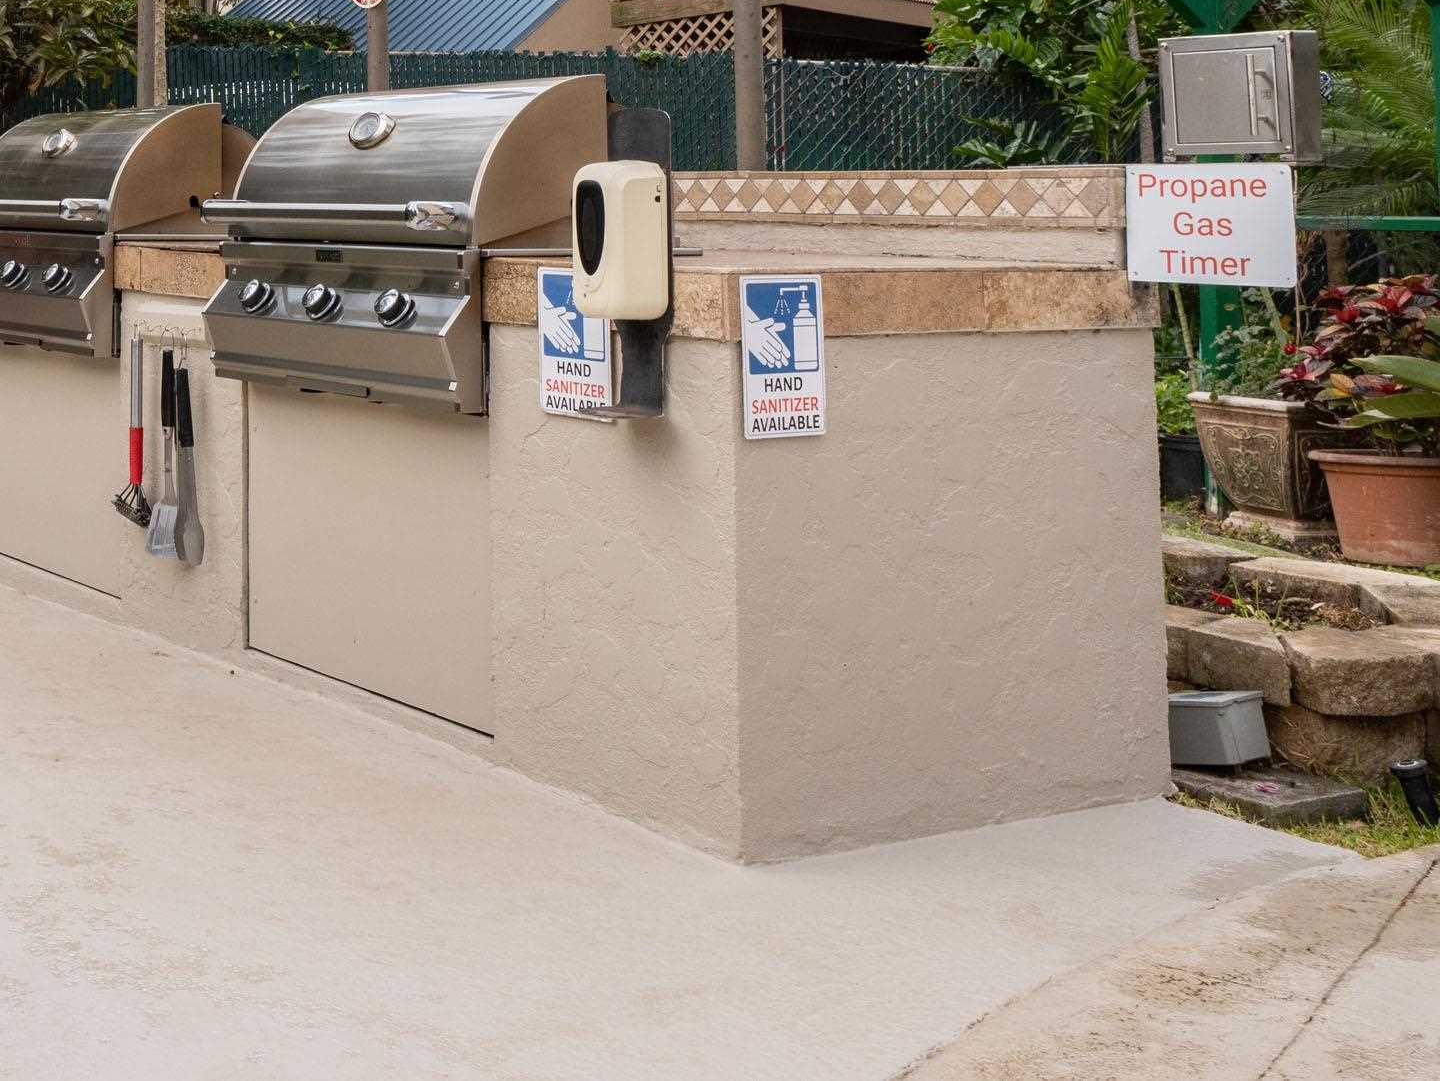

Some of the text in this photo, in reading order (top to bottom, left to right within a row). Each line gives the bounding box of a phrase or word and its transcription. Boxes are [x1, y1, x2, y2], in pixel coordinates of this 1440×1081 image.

[1138, 174, 1267, 203] Propane
[1173, 212, 1233, 237] Gas
[1159, 250, 1250, 276] Timer
[557, 360, 591, 377] HAND
[545, 379, 606, 399] SANITIZER
[764, 376, 803, 392] HAND
[751, 396, 819, 414] SANITIZER
[752, 414, 820, 433] AVAILABLE
